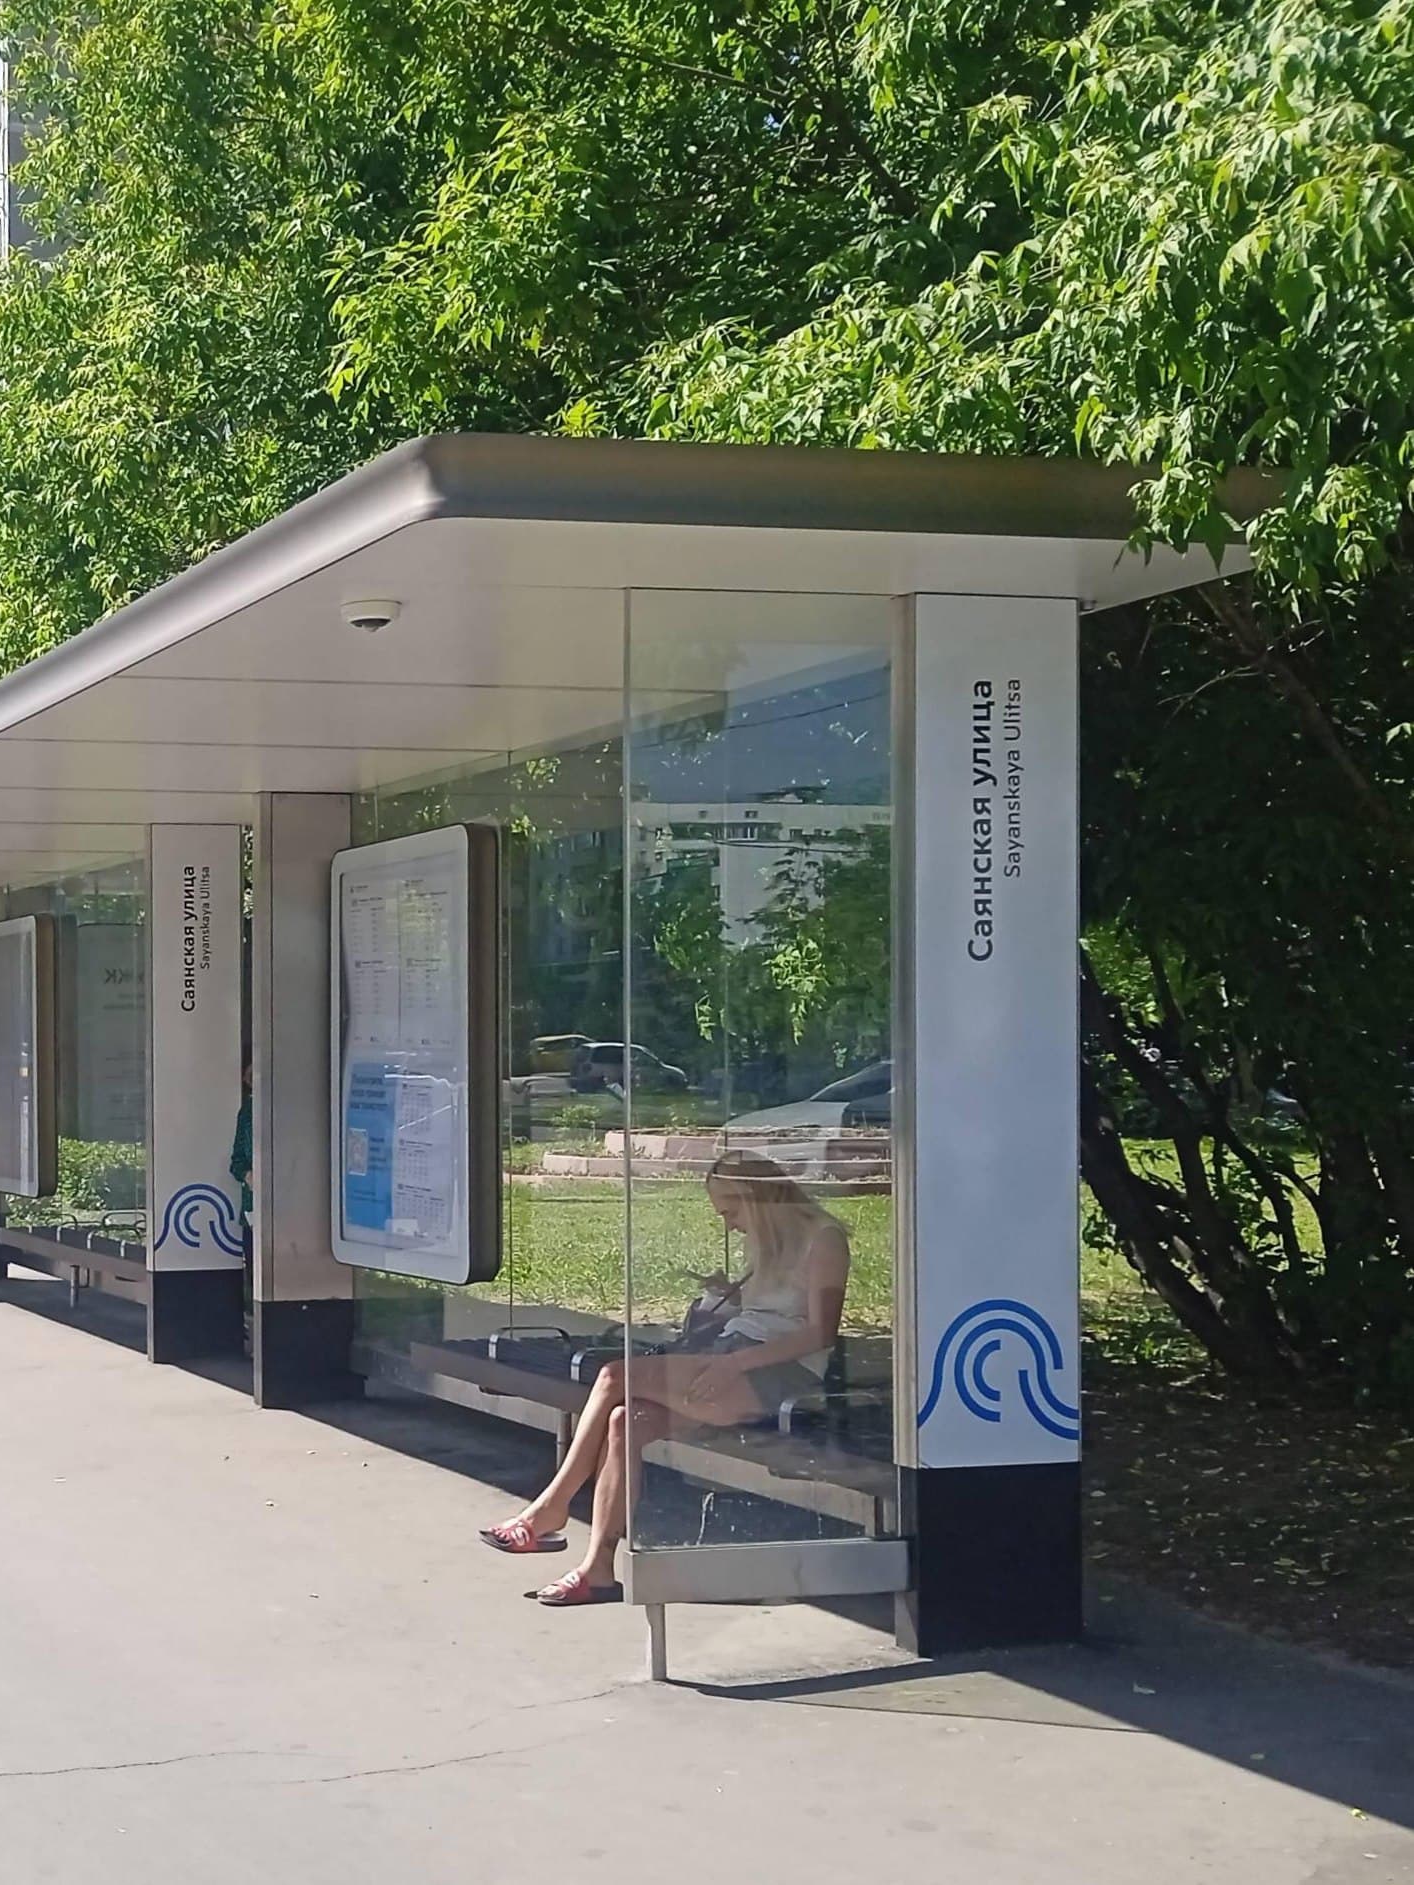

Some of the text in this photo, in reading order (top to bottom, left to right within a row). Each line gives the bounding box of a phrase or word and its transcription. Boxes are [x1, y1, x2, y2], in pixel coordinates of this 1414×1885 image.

[968, 680, 997, 962] Саянская улица
[1003, 678, 1025, 878] Sayanskaya Ulitsa
[181, 866, 198, 1012] Саянская улица
[200, 902, 213, 970] Sayanskaya
